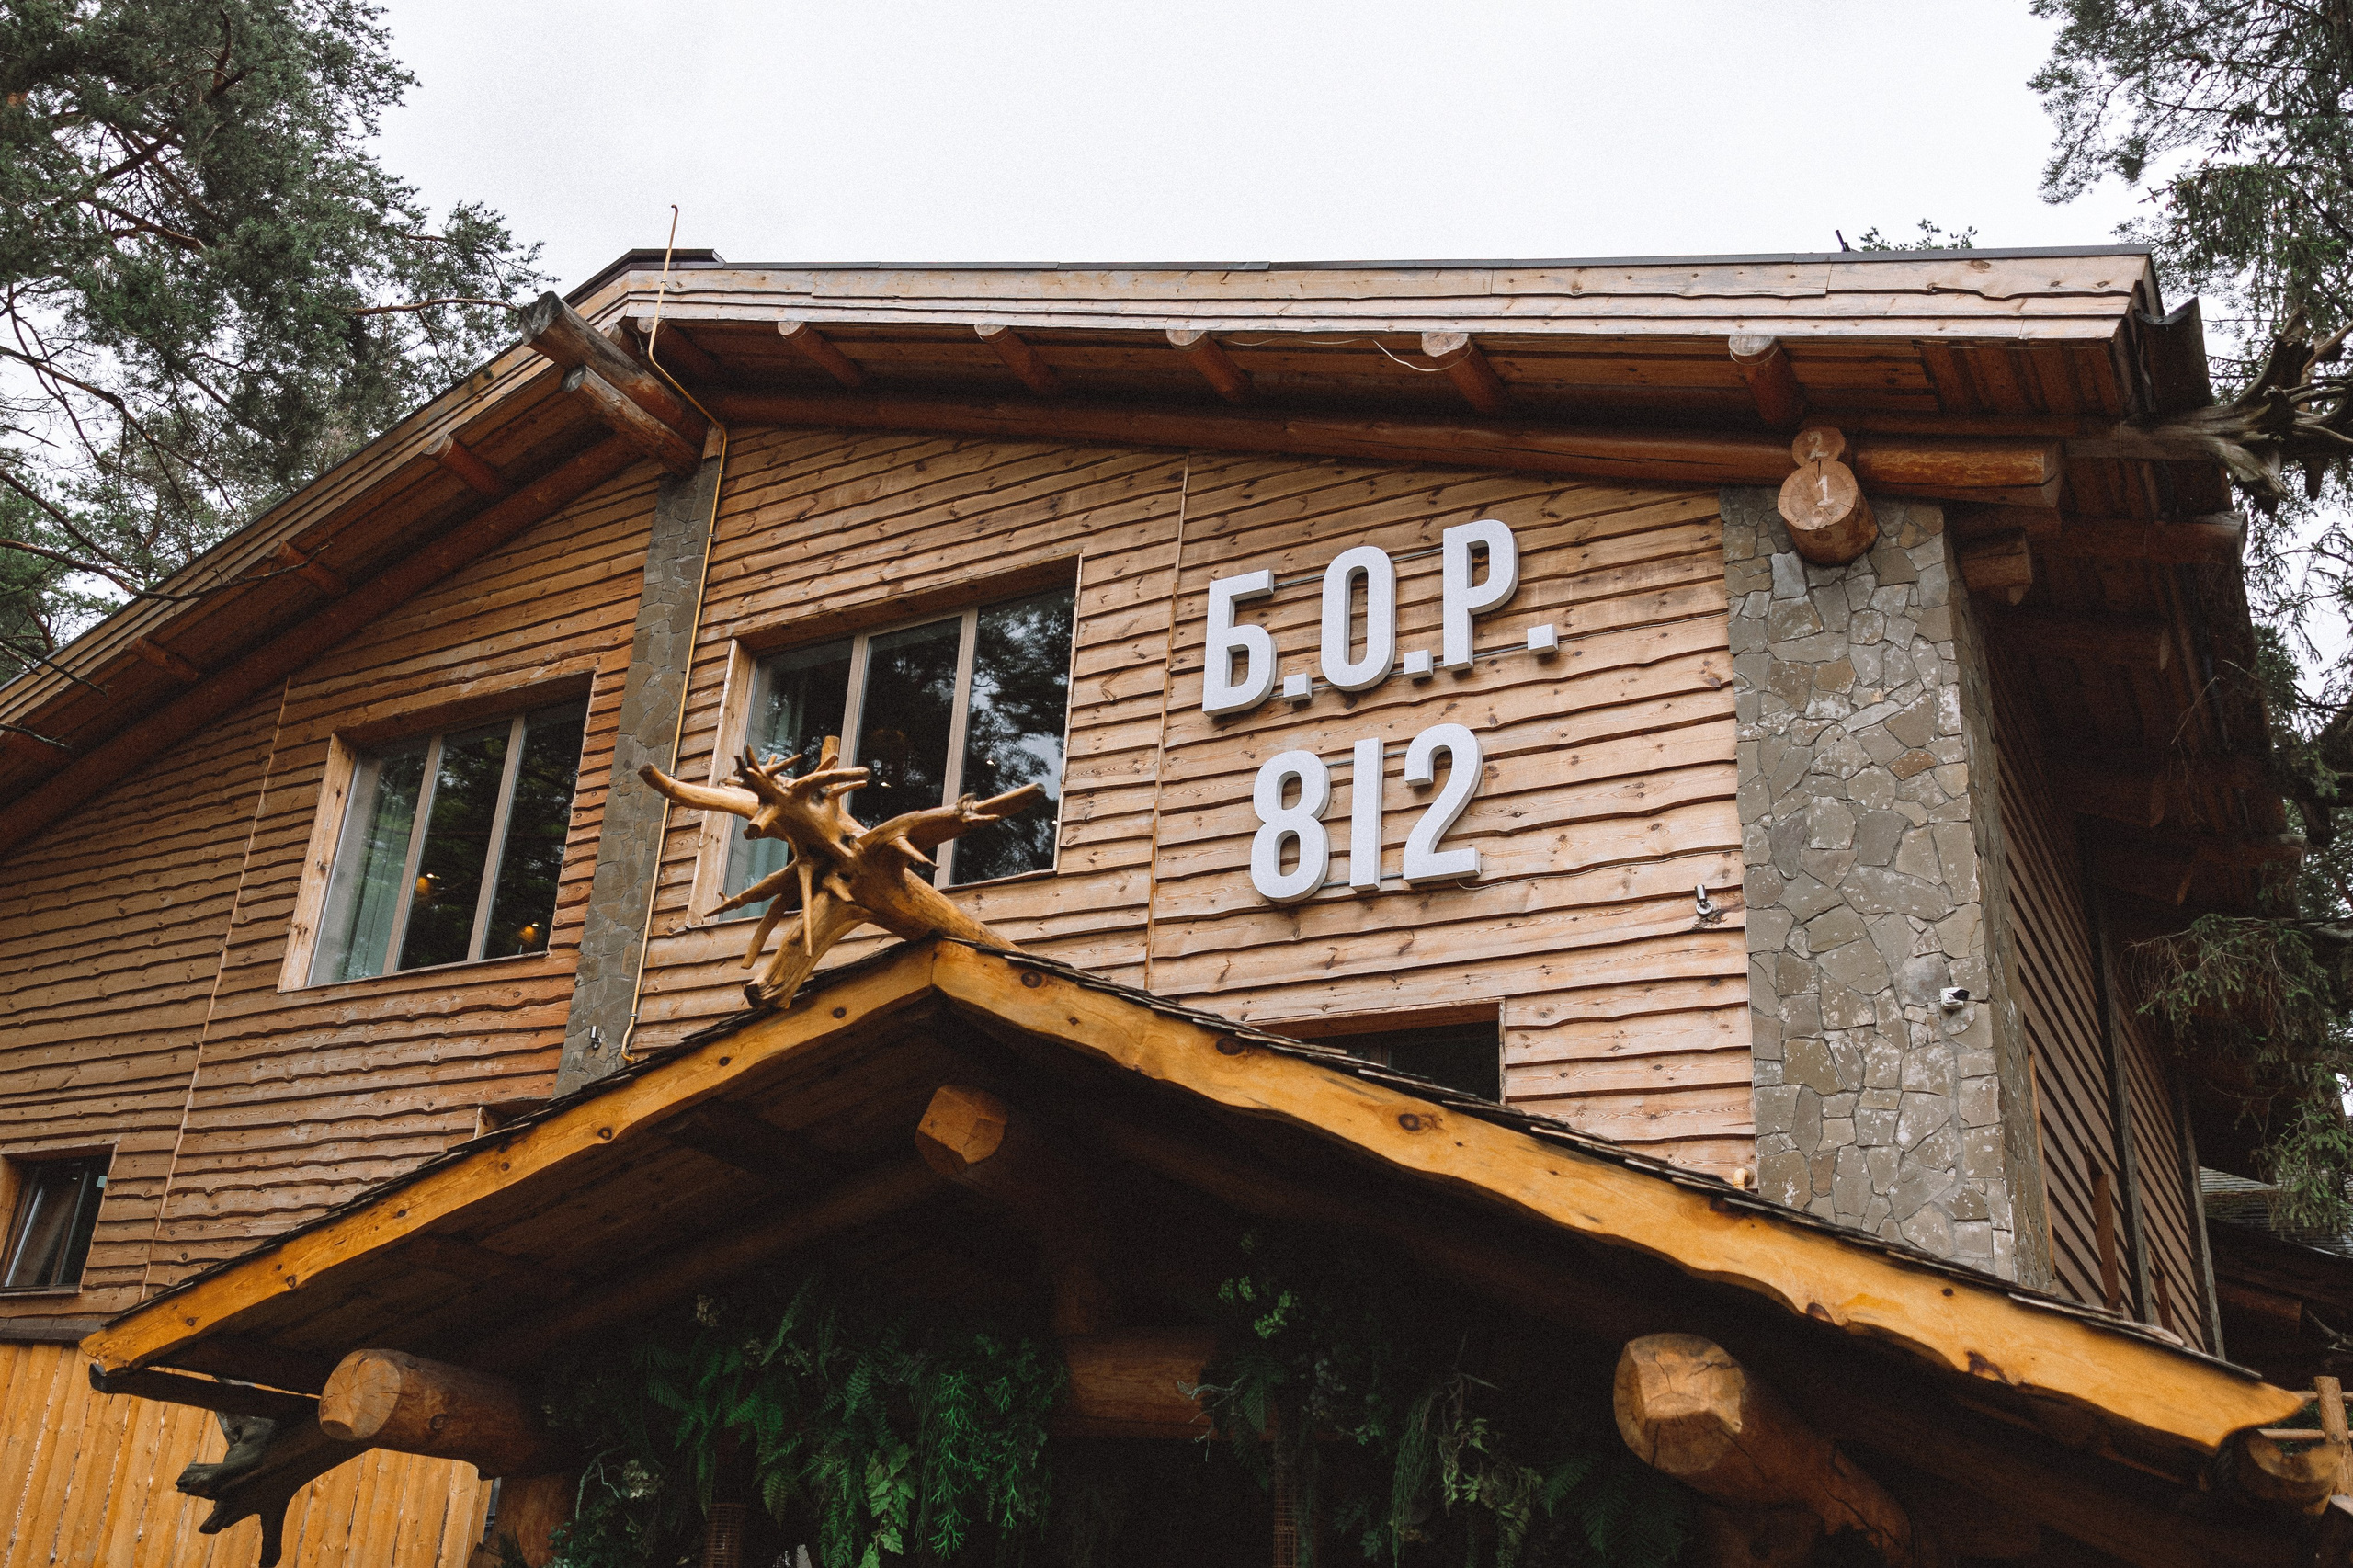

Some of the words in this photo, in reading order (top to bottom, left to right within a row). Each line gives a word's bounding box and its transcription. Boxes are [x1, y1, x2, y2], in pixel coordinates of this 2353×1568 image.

[1807, 431, 1829, 460] 2
[1816, 474, 1835, 506] 1
[1202, 519, 1559, 717] Б.О.Р.
[1250, 723, 1482, 903] 812
